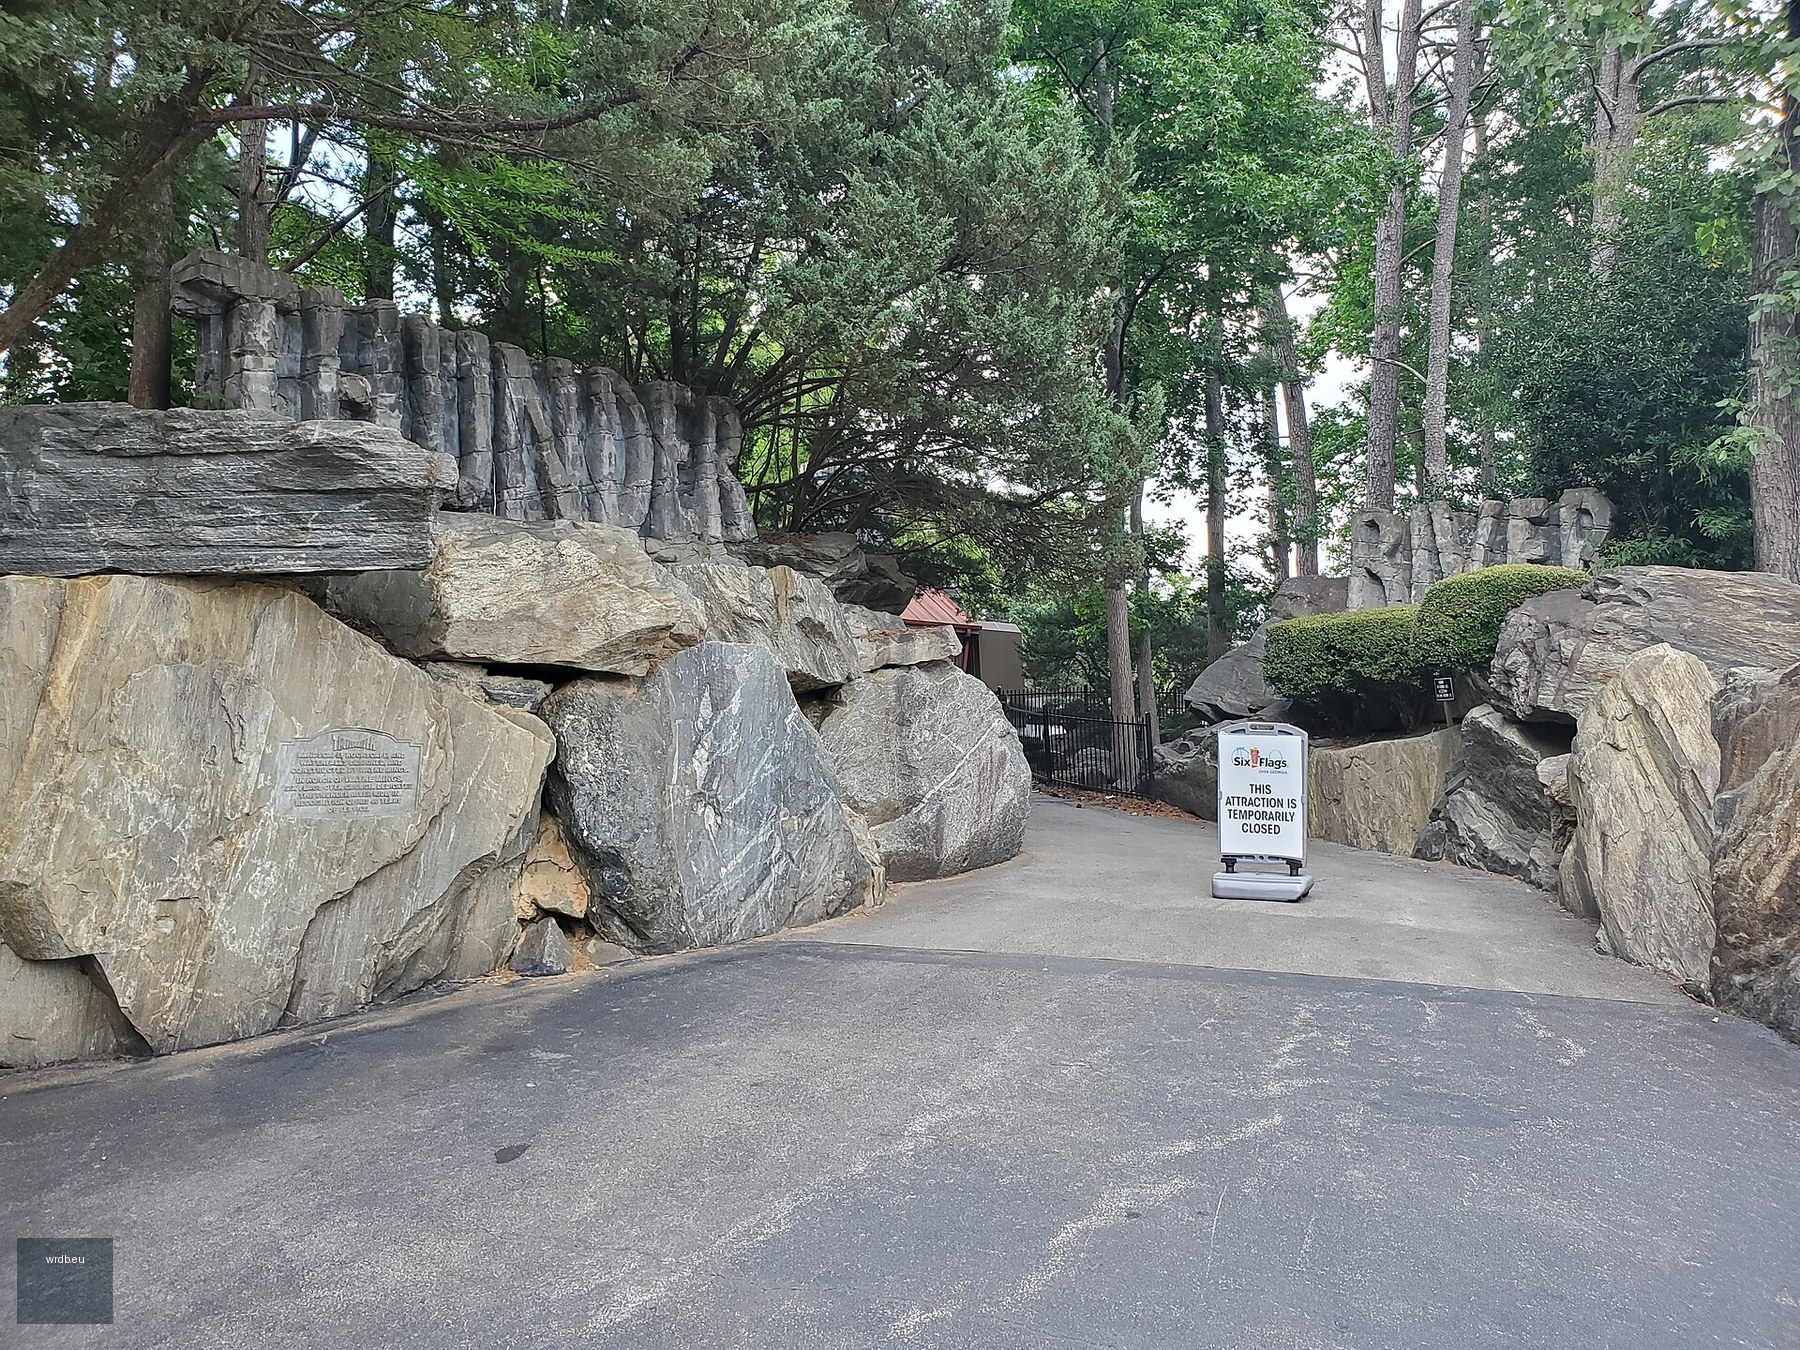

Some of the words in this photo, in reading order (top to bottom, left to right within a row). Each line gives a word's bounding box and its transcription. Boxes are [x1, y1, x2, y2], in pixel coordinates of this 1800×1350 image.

[1233, 757, 1250, 767] Six
[1259, 757, 1287, 770] Flags
[1249, 784, 1272, 795] THIS
[1225, 796, 1284, 809] ATTRACTION
[1287, 798, 1297, 809] IS
[1227, 809, 1295, 822] TEMPORARILY
[1241, 822, 1281, 835] CLOSED
